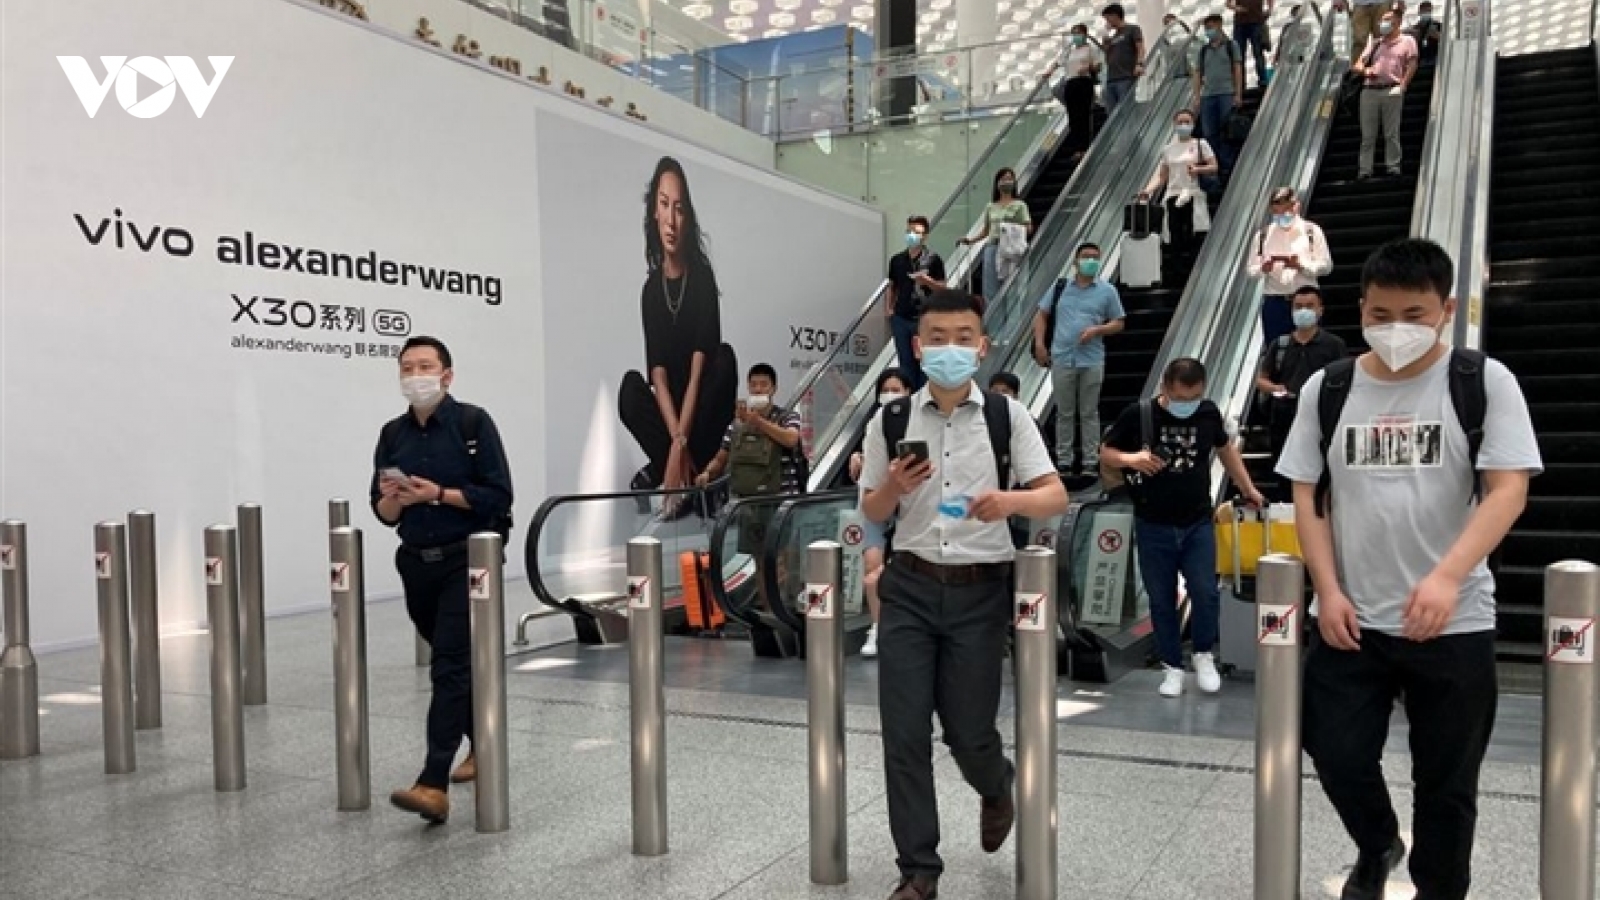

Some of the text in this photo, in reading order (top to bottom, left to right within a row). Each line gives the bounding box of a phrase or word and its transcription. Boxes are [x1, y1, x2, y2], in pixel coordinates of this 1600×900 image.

[73, 208, 503, 306] vivo alexanderwang
[230, 293, 407, 333] X30系列 5G
[230, 334, 352, 359] alexanderwang
